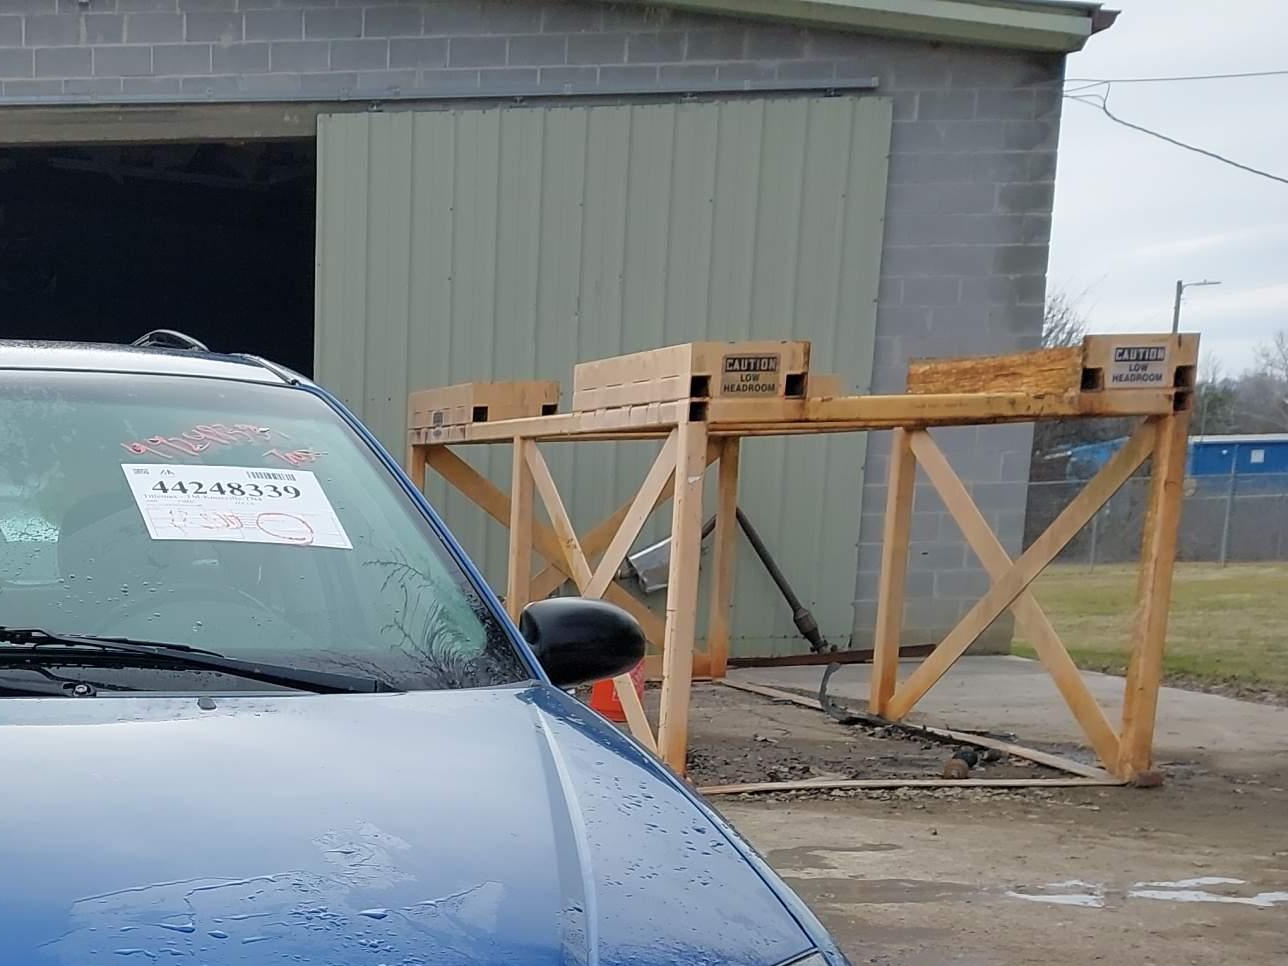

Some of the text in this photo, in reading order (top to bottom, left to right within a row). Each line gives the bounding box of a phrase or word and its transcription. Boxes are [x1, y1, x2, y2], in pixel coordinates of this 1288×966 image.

[1116, 348, 1164, 360] CAUTION
[726, 358, 776, 370] CAUTION
[1129, 363, 1148, 372] LOW
[740, 373, 760, 382] LOW
[1112, 373, 1163, 382] HEADROOM
[723, 383, 776, 392] HEADROOM
[152, 480, 301, 498] 44248339
